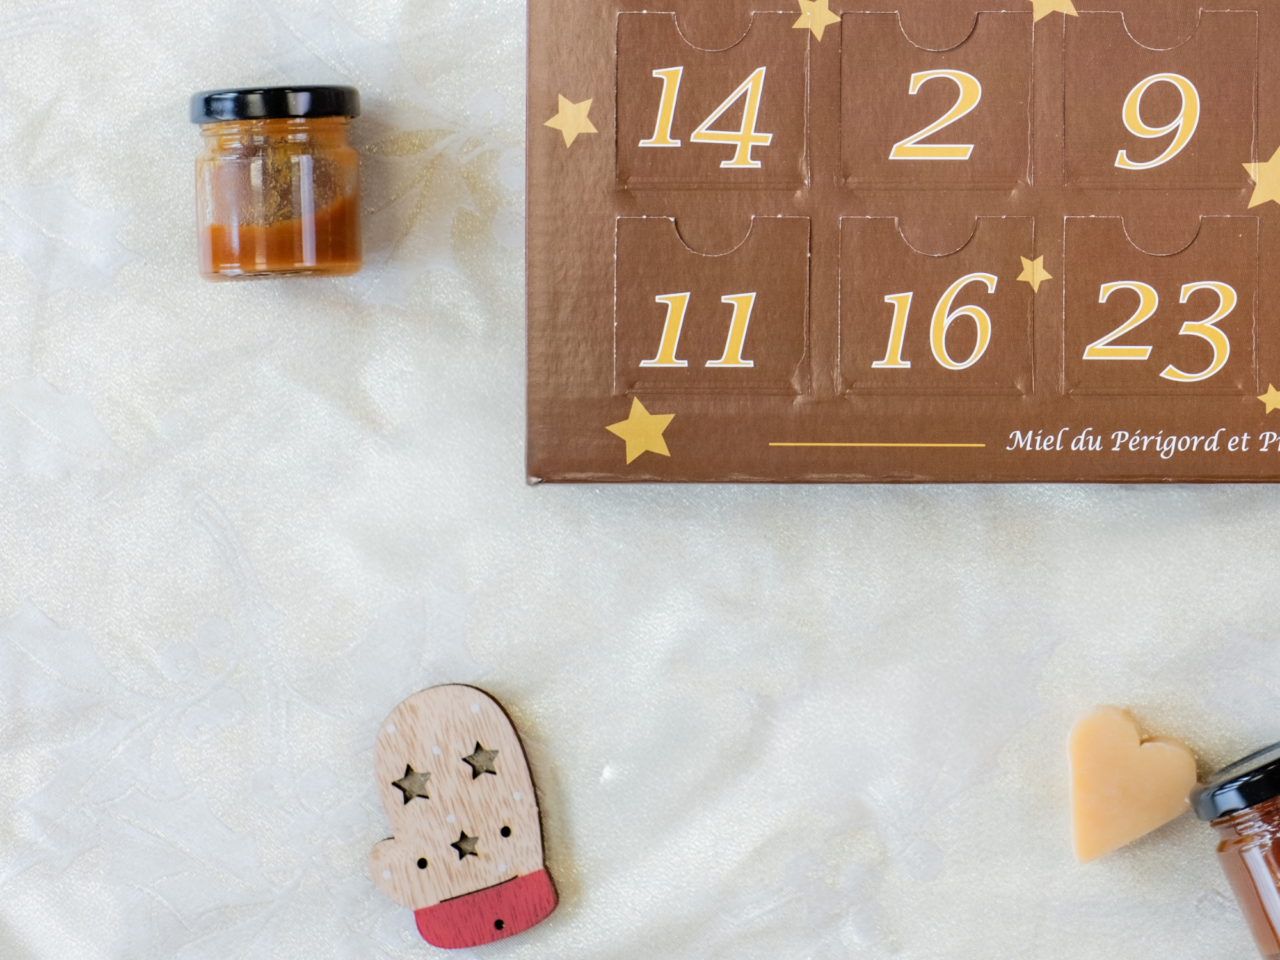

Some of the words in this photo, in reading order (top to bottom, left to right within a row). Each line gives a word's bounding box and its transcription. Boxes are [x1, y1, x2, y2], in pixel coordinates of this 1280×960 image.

[638, 65, 773, 169] 14
[888, 68, 982, 161] 2
[1114, 72, 1200, 171] 9
[639, 291, 756, 368] 11
[871, 271, 998, 371] 16
[1082, 280, 1237, 383] 23
[1006, 427, 1069, 451] Miel
[1071, 427, 1103, 452] du
[1111, 427, 1226, 460] Périgord
[1227, 432, 1250, 452] et
